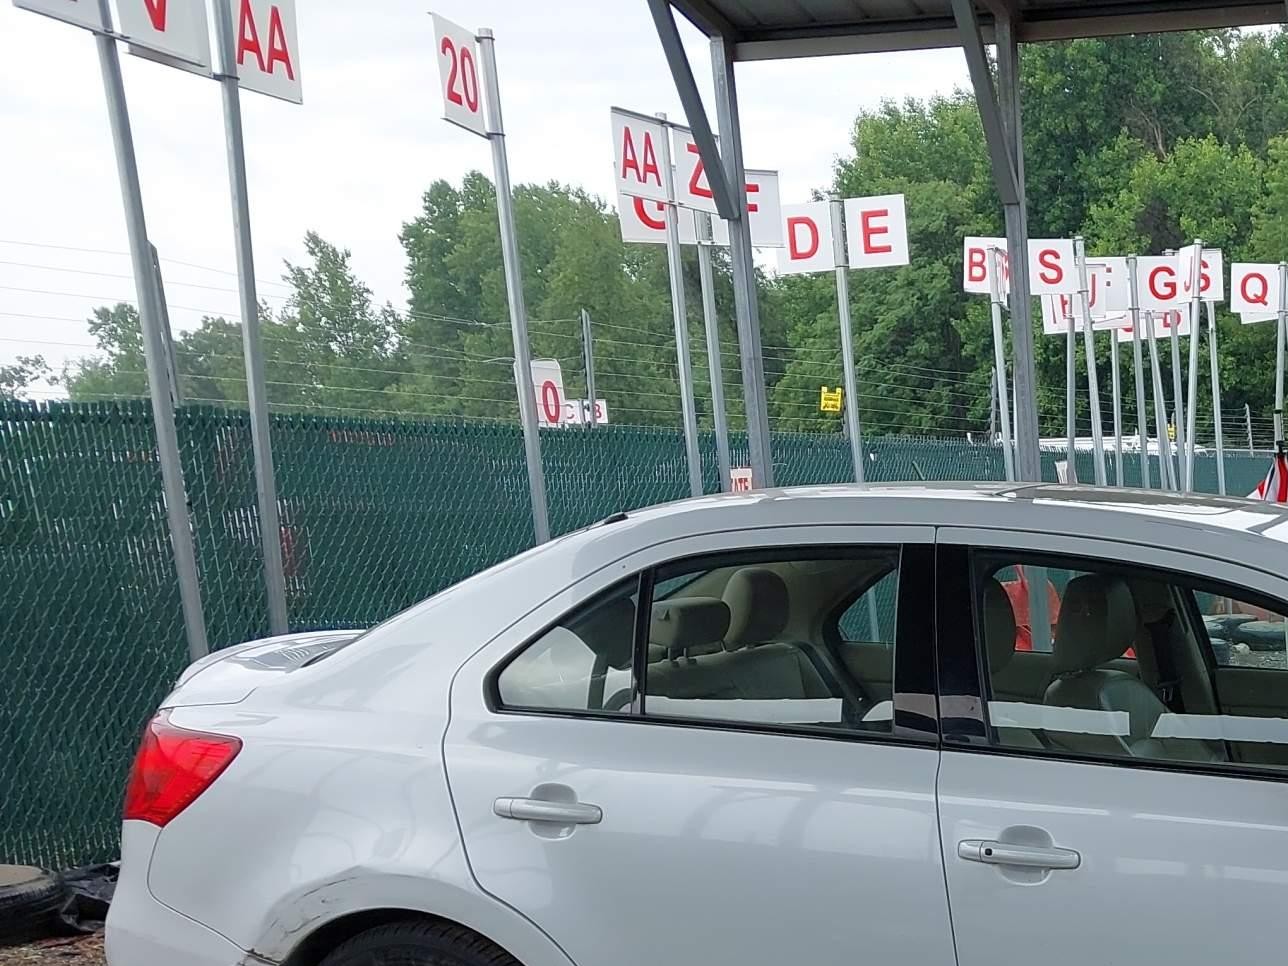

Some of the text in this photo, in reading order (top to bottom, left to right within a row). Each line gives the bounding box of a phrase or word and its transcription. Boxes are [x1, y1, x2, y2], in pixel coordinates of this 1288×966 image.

[237, 0, 295, 80] AA
[442, 36, 478, 113] 20
[622, 126, 662, 187] AA
[787, 216, 819, 260] D
[861, 209, 892, 254] E
[968, 247, 987, 282] B
[1038, 249, 1063, 284] S
[1148, 266, 1177, 300] G
[1240, 272, 1268, 306] Q
